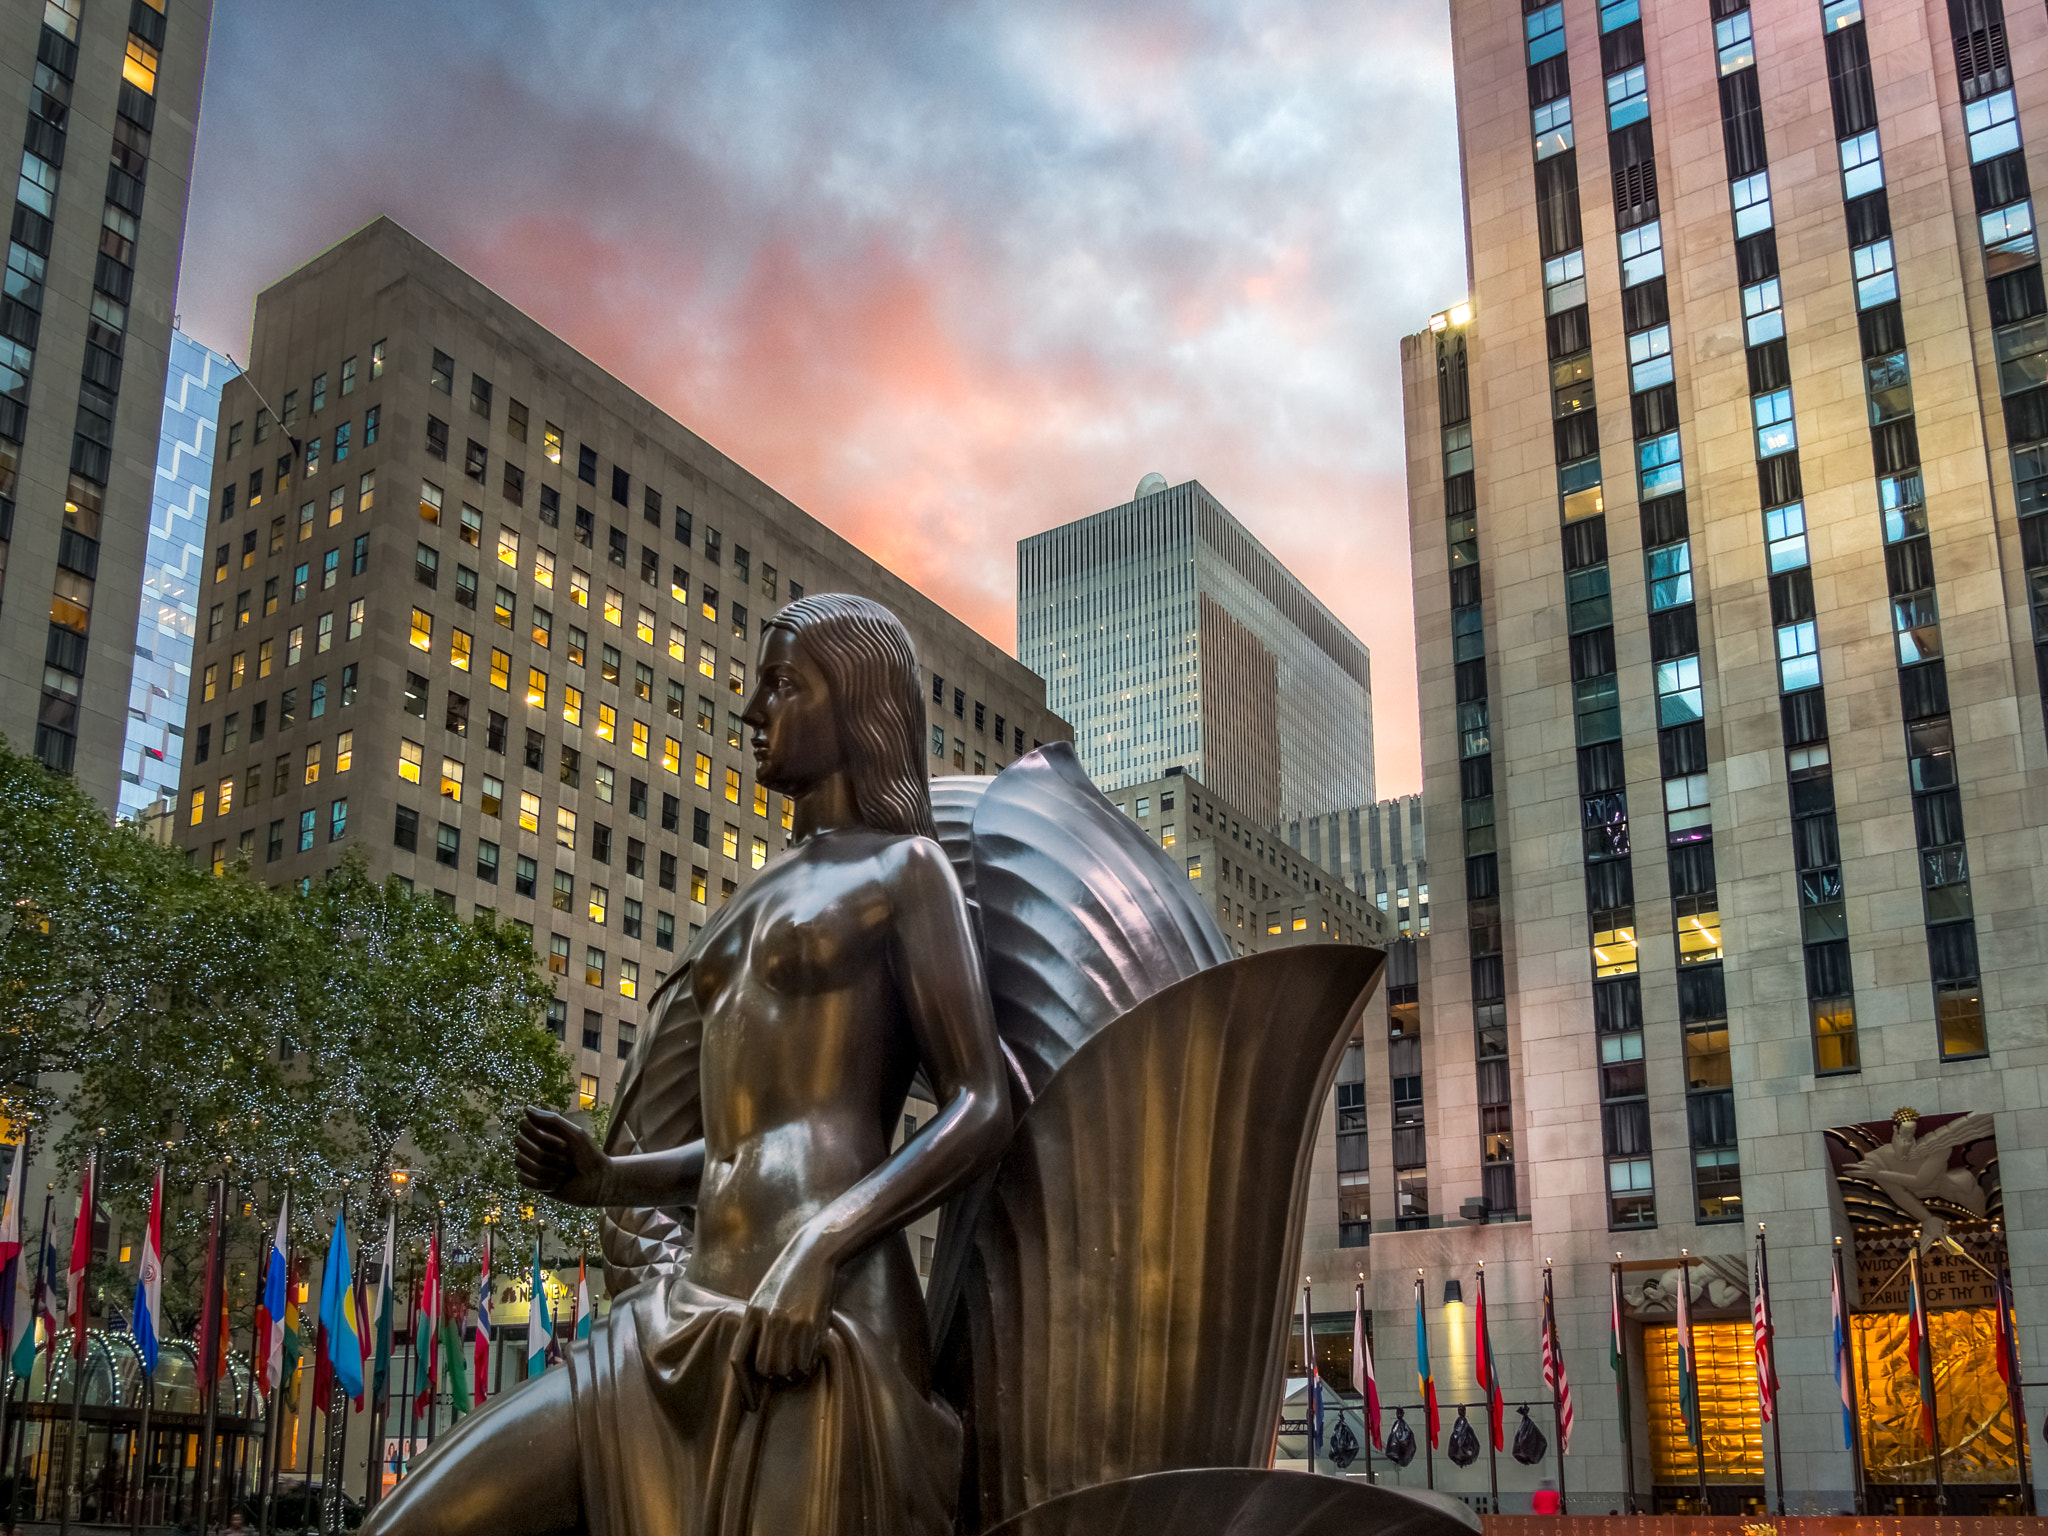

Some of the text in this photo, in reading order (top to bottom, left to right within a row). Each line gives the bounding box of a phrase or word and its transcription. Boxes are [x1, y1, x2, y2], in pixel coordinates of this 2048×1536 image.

[1857, 1258, 1911, 1273] WISDO
[1940, 1271, 1955, 1284] BE
[1959, 1269, 1980, 1283] THE
[1926, 1288, 1946, 1302] OF
[1949, 1286, 1975, 1300] THY
[167, 1415, 185, 1425] SEA
